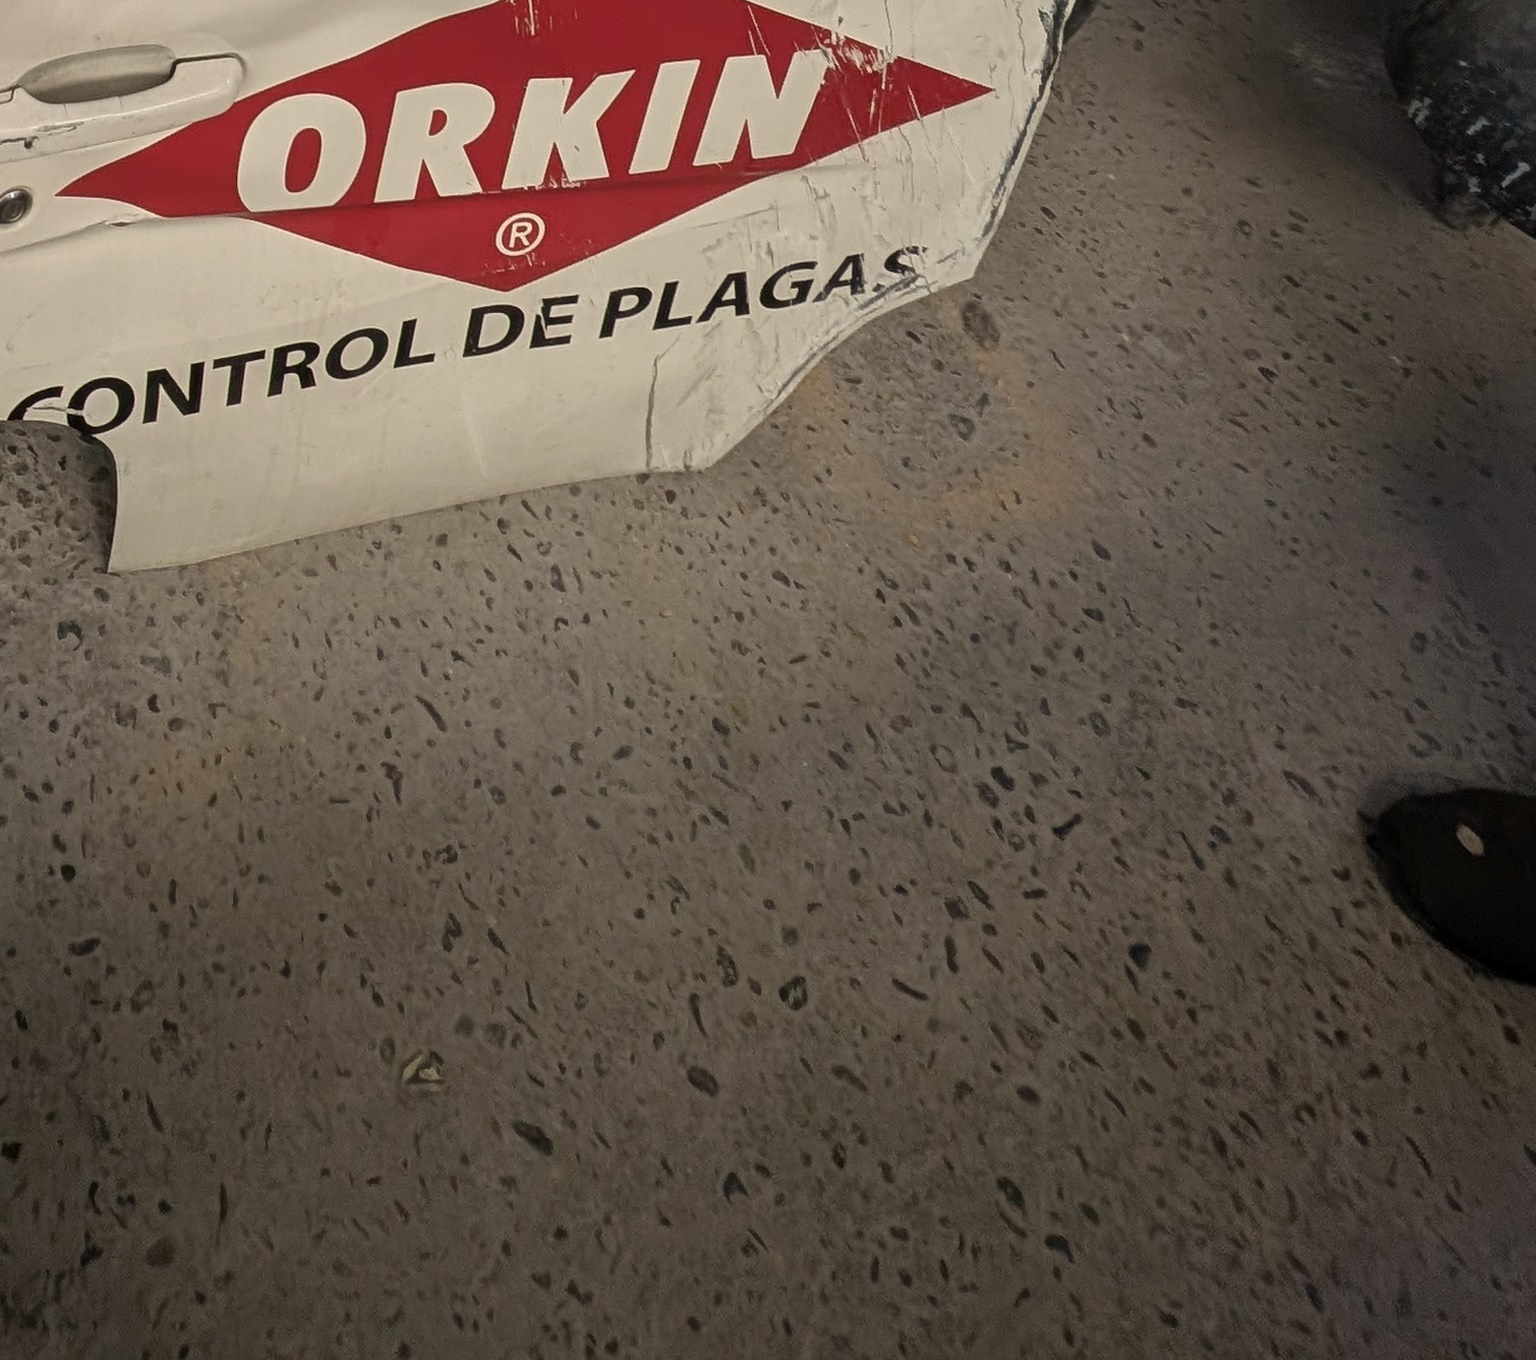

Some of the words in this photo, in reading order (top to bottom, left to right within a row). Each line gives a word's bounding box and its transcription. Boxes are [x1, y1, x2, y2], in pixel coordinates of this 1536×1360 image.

[236, 50, 829, 214] ORKIN
[7, 319, 435, 436] CONTROL
[462, 295, 581, 359] DE
[598, 245, 929, 339] PLAGAS
